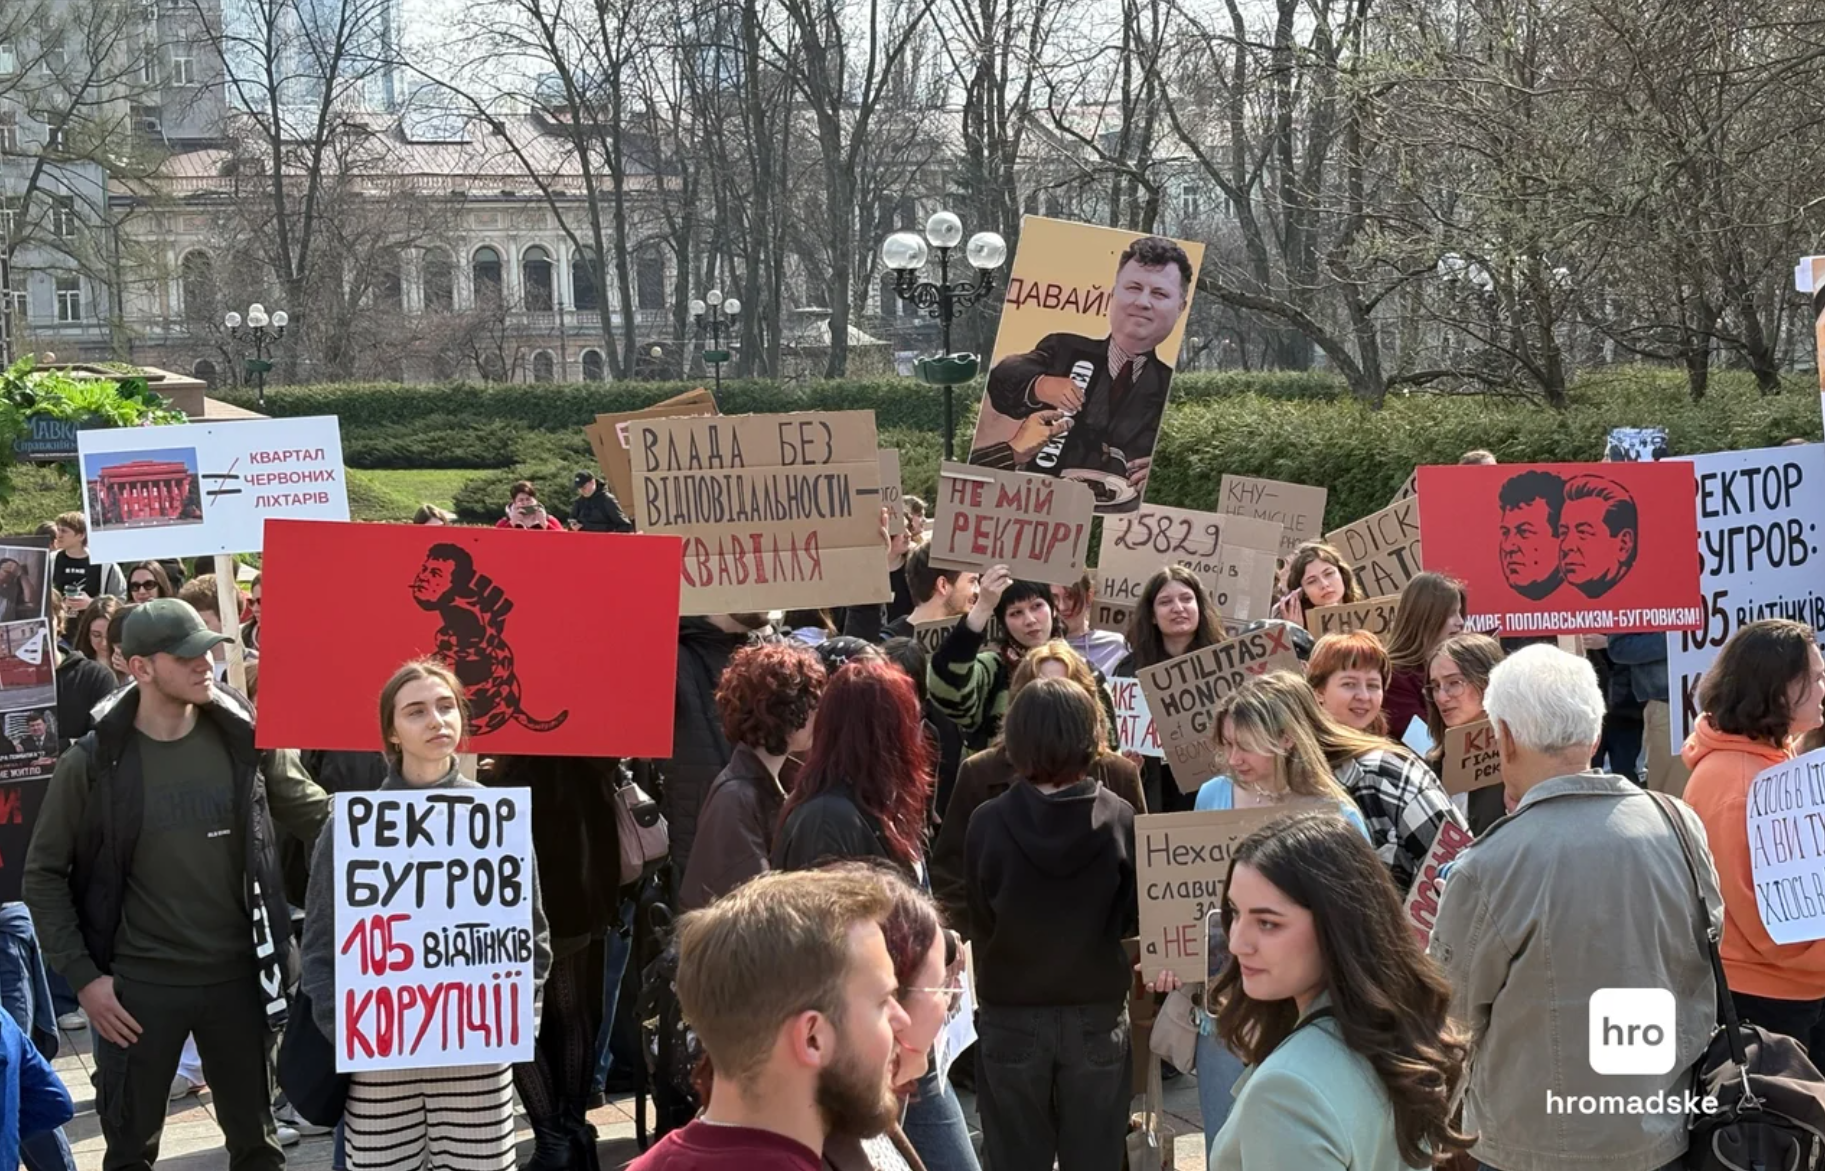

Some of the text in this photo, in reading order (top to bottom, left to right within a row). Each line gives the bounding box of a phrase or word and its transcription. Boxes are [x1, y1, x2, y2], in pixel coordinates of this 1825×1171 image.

[1006, 277, 1110, 318] ДАВАЙ!
[249, 448, 325, 465] КВАРТАЛ
[642, 424, 745, 472] ВЛАДА
[778, 420, 833, 467] БЕЗ
[243, 469, 336, 487] ЧЕРВОНИХ
[254, 491, 330, 509] ЛІХТАРІВ
[950, 478, 985, 507] НЕ
[1695, 462, 1803, 518] ЕКТОР
[949, 511, 1084, 568] РЕКТОР!
[1114, 514, 1220, 557] 25829
[1506, 607, 1701, 631] ПОПЛАВСЬКИЗМ-БУГРОВИЗМ!
[1151, 634, 1266, 691] UTILITAS
[347, 795, 516, 849] РЕКТОР
[1754, 823, 1771, 869] А
[1771, 815, 1806, 864] ВИ
[346, 854, 528, 909] БУГРОВ:
[1756, 876, 1818, 925] ХТОСЬ
[341, 913, 415, 976] 105
[1163, 924, 1199, 958] НЕ
[345, 971, 522, 1060] КОРУПЦІЇ
